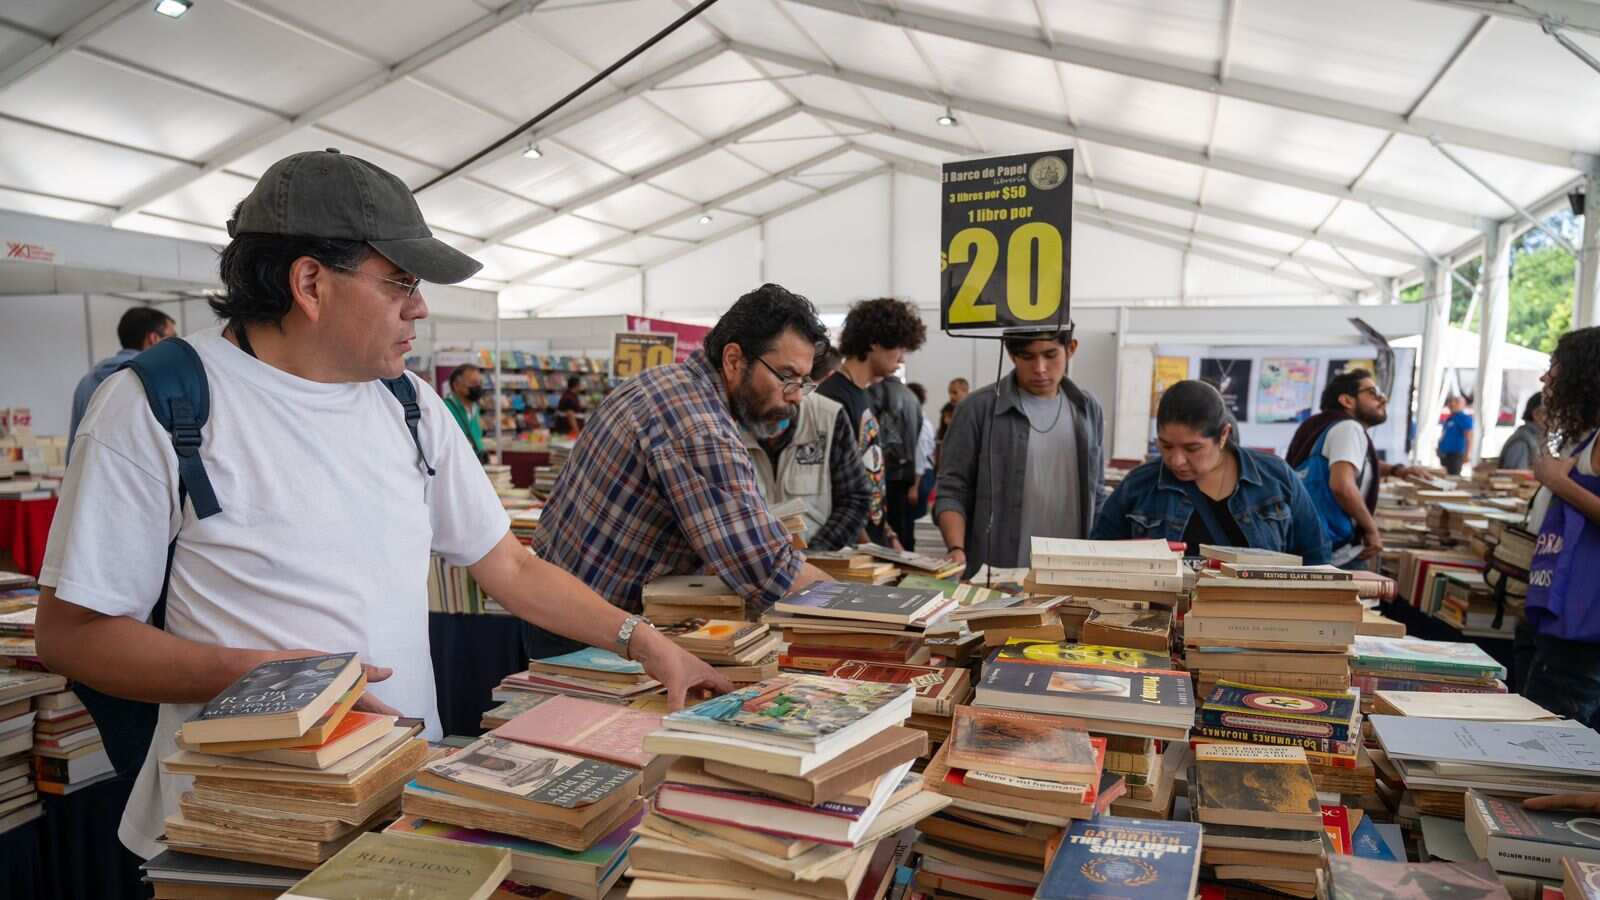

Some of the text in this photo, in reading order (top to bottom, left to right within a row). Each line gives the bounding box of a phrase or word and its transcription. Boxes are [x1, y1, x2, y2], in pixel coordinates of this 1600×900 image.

[950, 168, 980, 182] Barco
[982, 167, 995, 178] de
[997, 162, 1027, 177] Papel
[949, 185, 1027, 203] 3 libros por $50
[968, 205, 1033, 223] 1 libro por
[617, 343, 674, 378] 50
[219, 692, 318, 705] ROAD
[1202, 727, 1318, 751] COSTUMBRES RIOJANAS
[1070, 834, 1192, 855] THE AFFLUENT
[1084, 829, 1181, 846] GALBRAITH
[1088, 843, 1166, 860] SOCIETY
[357, 851, 473, 877] RELECCIONES
